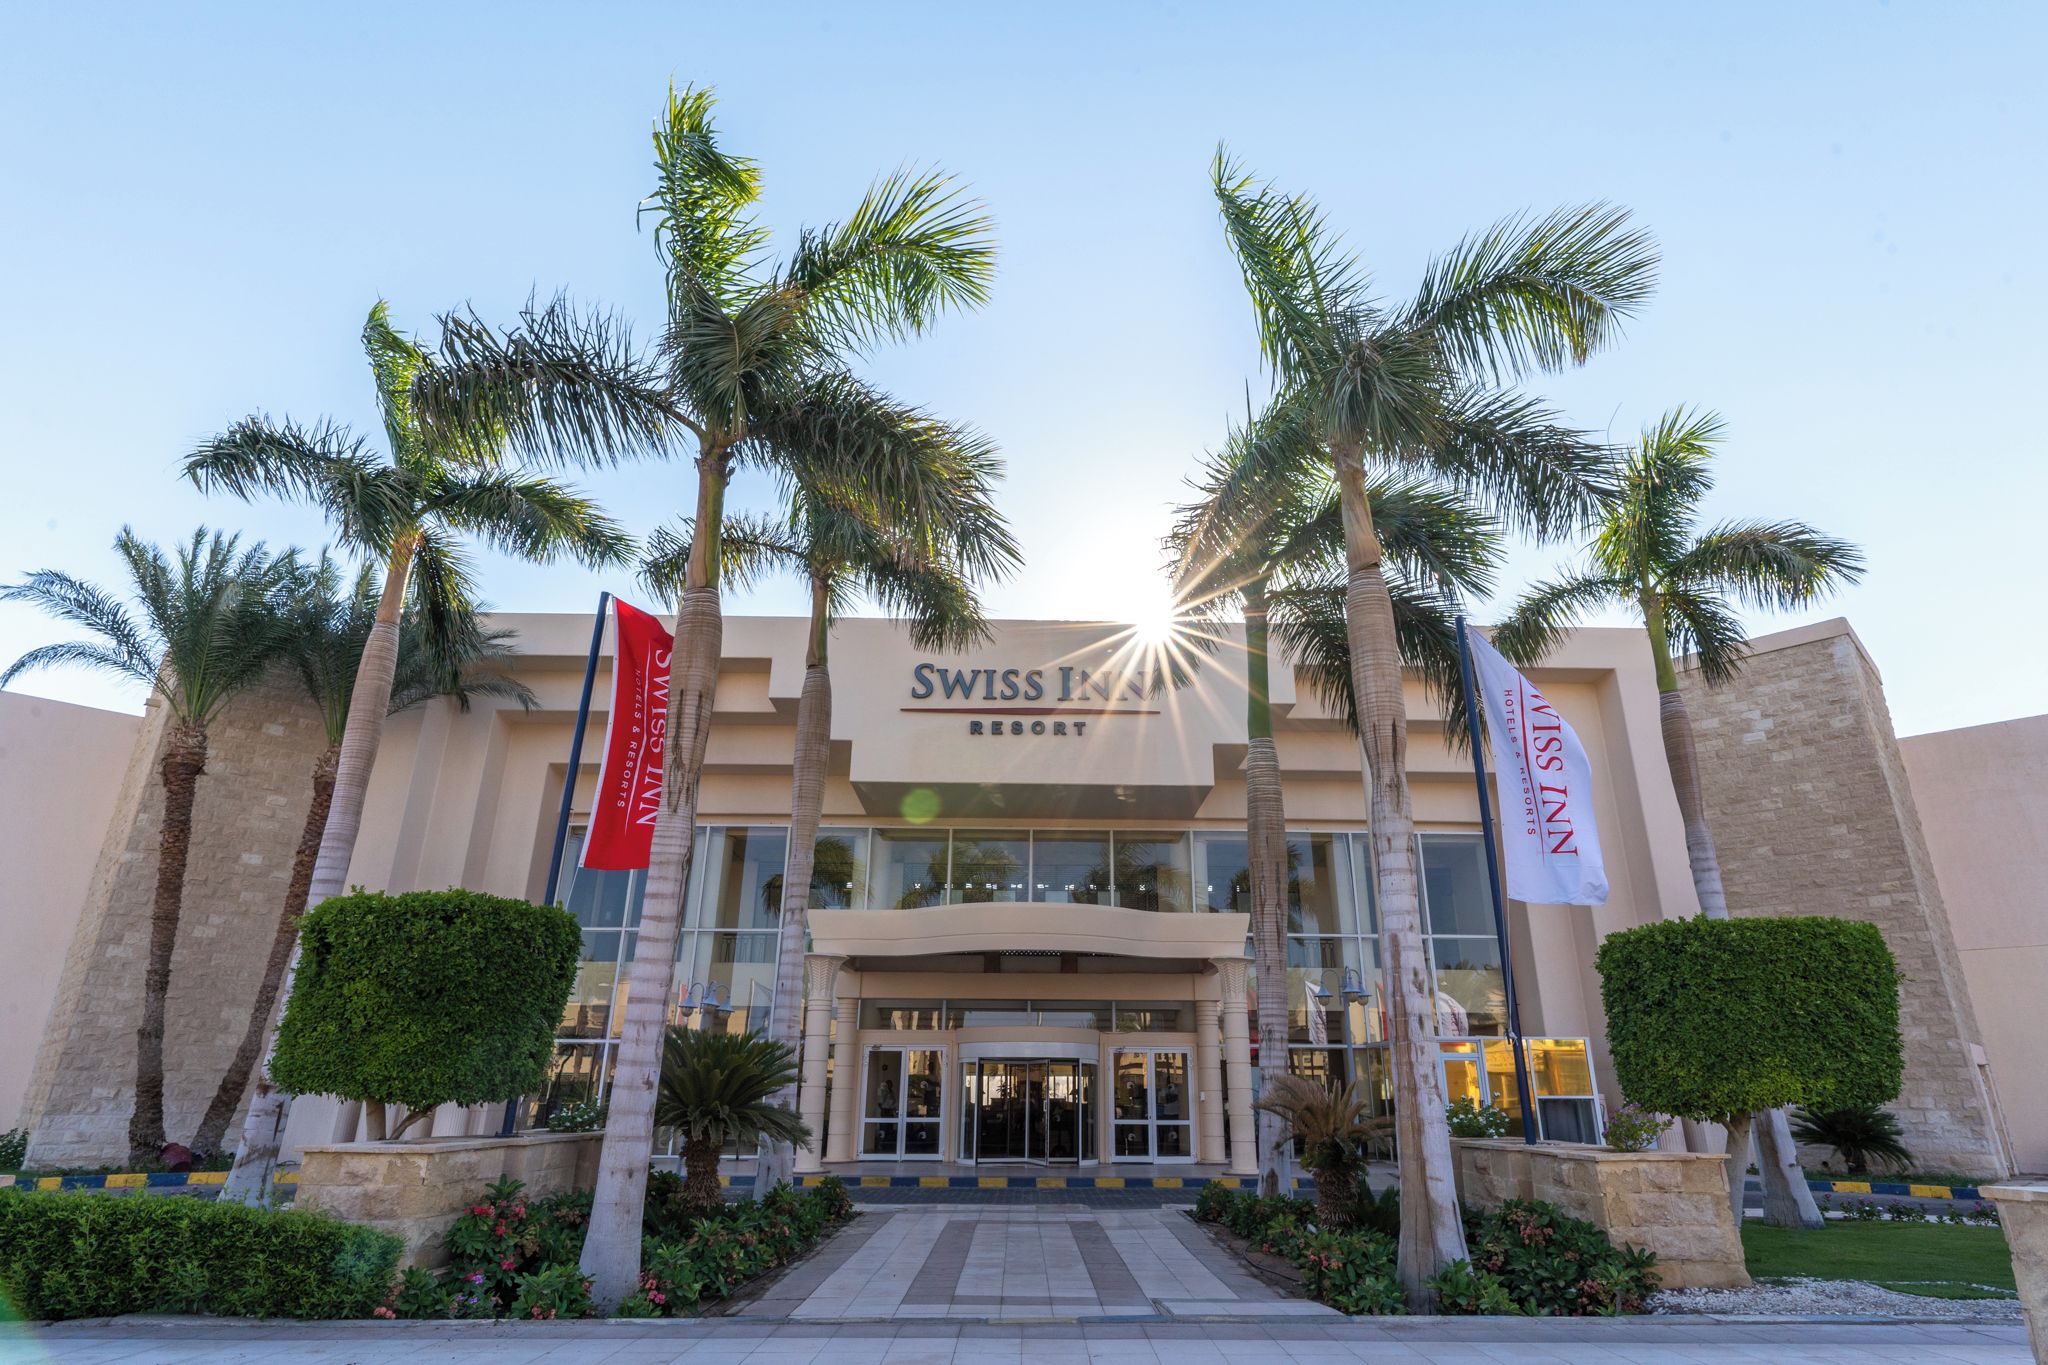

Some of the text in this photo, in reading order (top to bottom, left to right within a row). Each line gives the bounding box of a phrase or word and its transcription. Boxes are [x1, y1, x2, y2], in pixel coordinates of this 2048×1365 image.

[911, 663, 1151, 701] SWISS INN
[617, 668, 643, 807] HOTELS & RESORTS
[970, 720, 1086, 737] RESORT
[1503, 689, 1536, 835] HOTELS & RESORTS
[1539, 782, 1578, 856] INN
